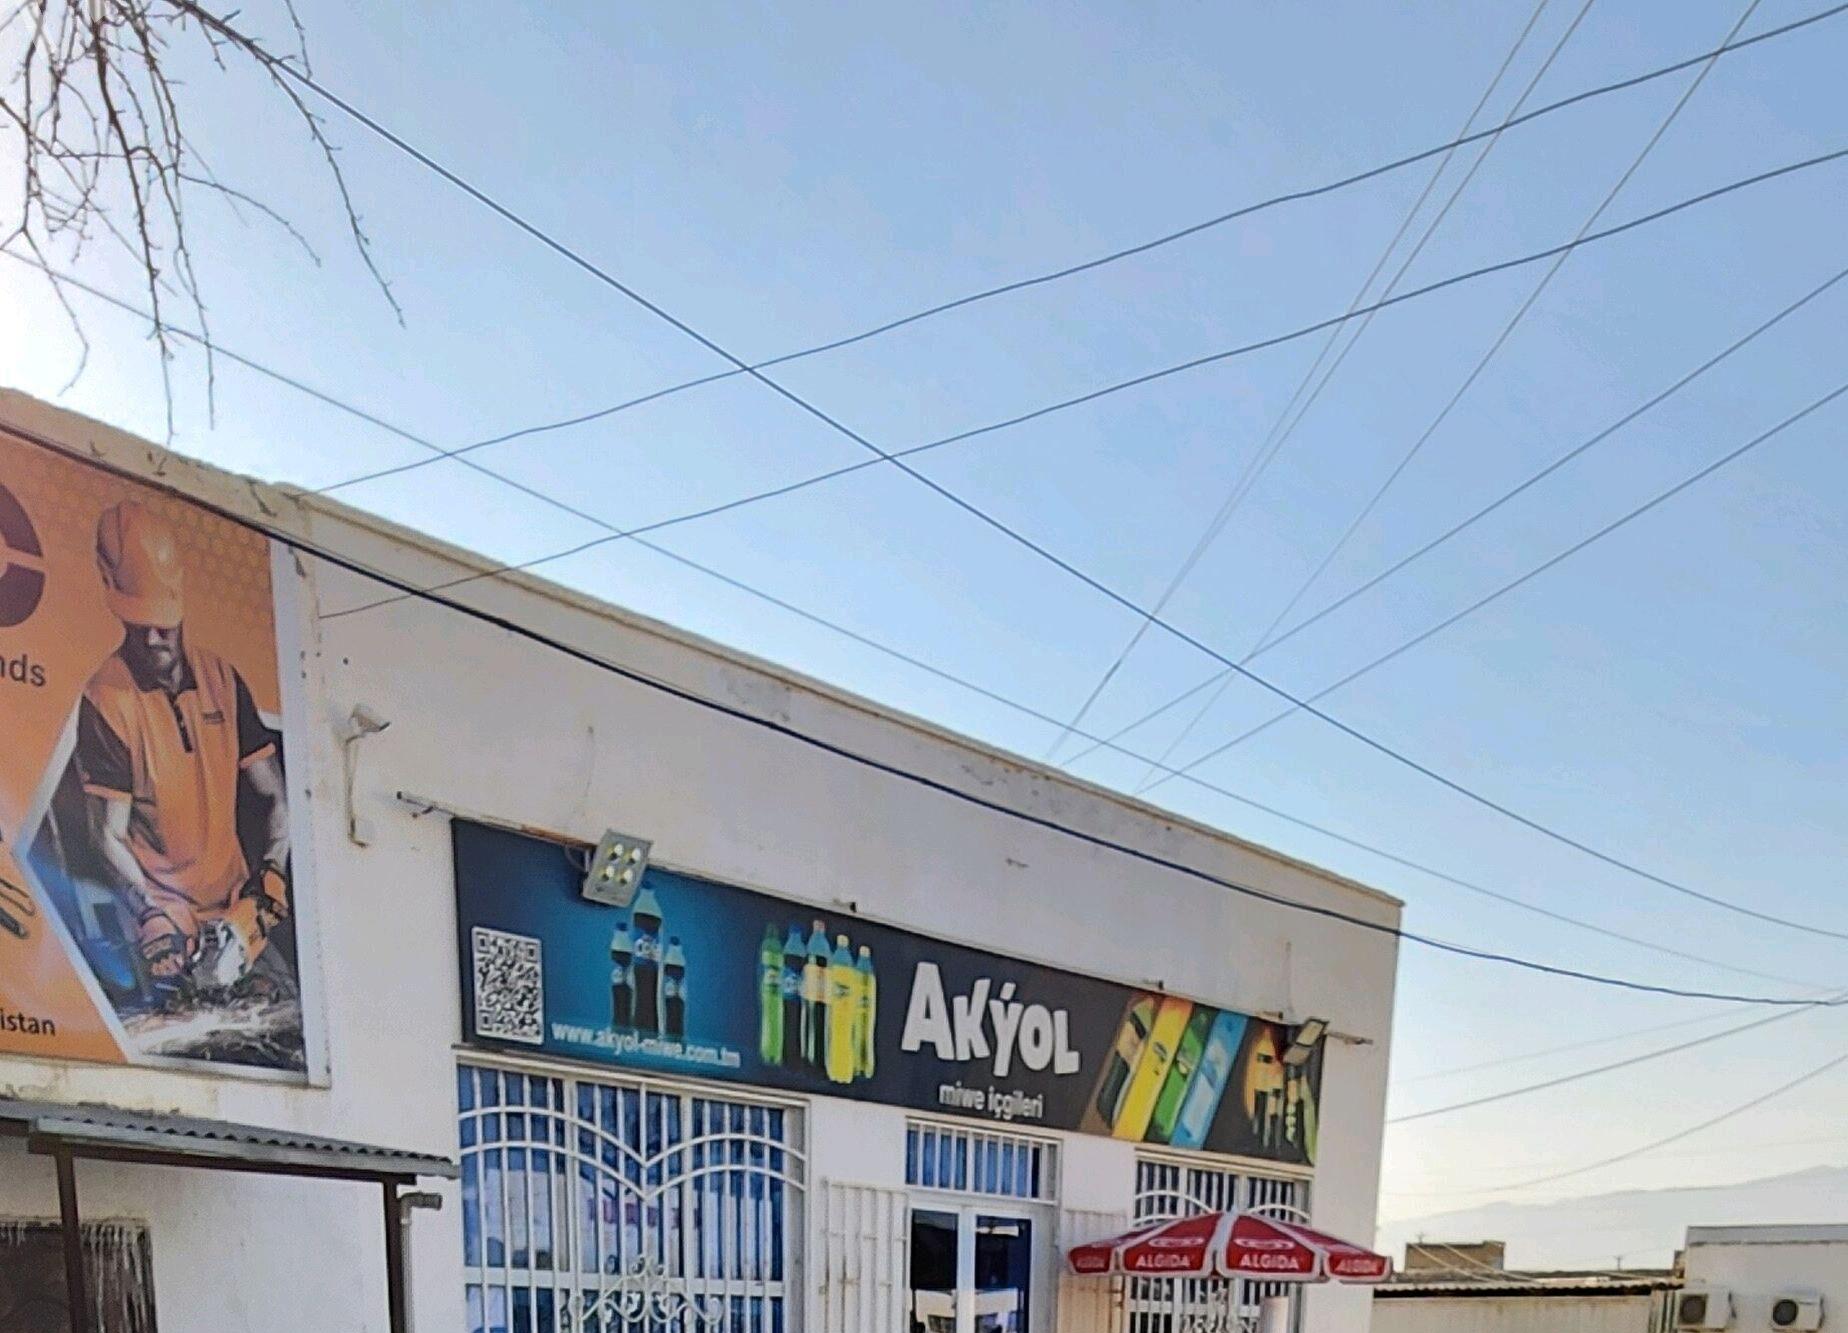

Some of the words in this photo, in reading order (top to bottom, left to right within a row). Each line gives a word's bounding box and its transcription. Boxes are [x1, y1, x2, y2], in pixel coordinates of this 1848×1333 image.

[939, 1080, 985, 1110] miwe
[1136, 1254, 1190, 1268] ALGIDA
[1239, 1253, 1300, 1270] ALGIDA
